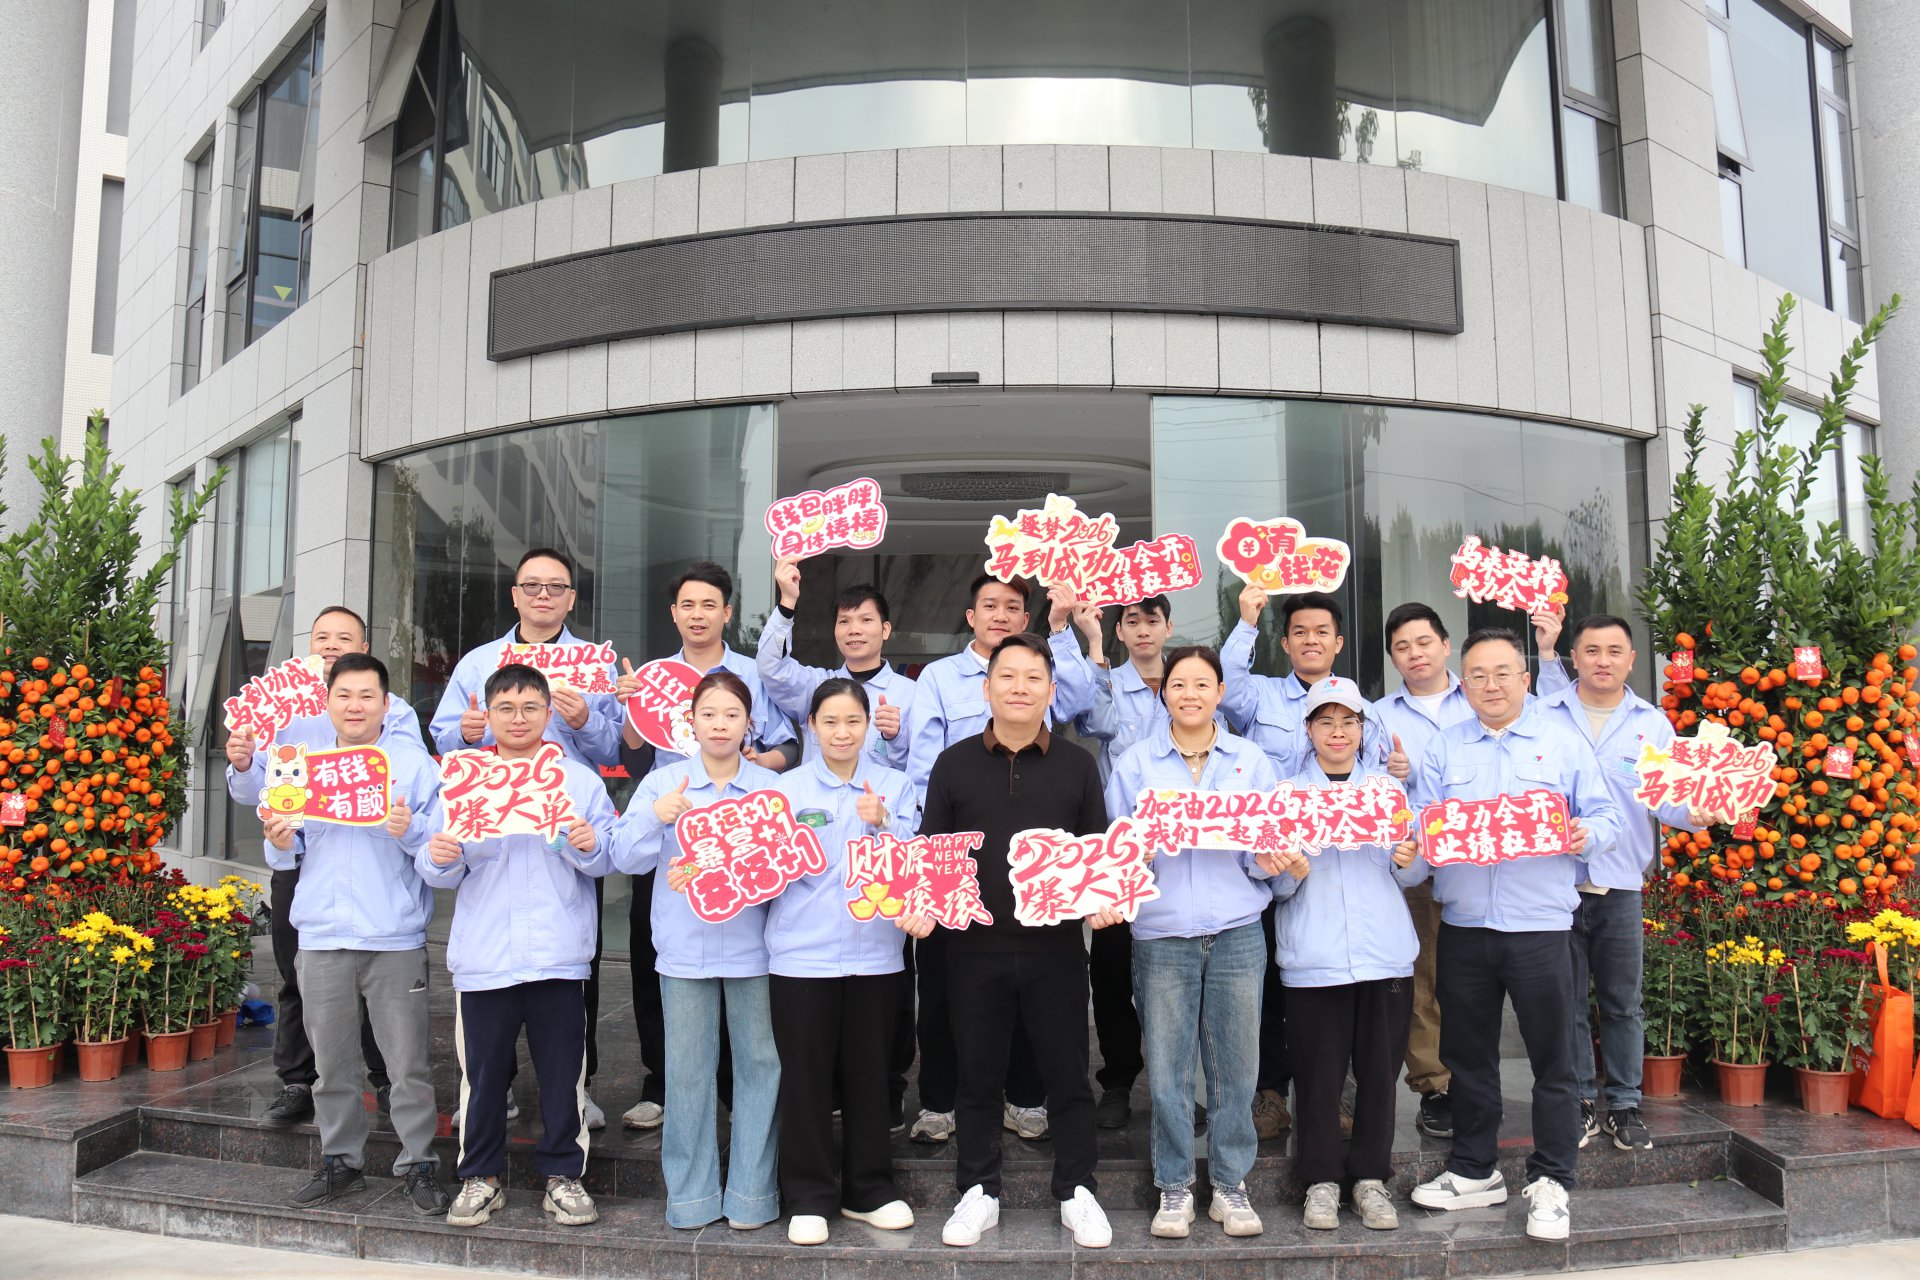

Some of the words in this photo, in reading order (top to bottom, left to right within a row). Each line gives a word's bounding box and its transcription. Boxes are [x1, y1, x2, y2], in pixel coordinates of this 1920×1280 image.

[772, 484, 872, 531] 钱包胖胖
[780, 508, 880, 556] 身体棒棒
[1116, 536, 1184, 575] 力全开
[990, 542, 1116, 589] 马到成功
[1451, 535, 1562, 596] 马来运转
[1453, 573, 1550, 614] 火力全开
[497, 641, 617, 669] 加油2026
[226, 658, 319, 730] 马到功成
[542, 666, 617, 694] 一起赢
[643, 662, 688, 704] 红红
[314, 754, 371, 788] 有钱
[443, 748, 565, 800] 2026
[1669, 740, 1774, 777] 逐梦2026
[327, 785, 386, 819] 有颜
[448, 790, 575, 839] 爆大单
[1136, 789, 1286, 821] 加油2026
[1276, 776, 1398, 827] 马来运转
[1442, 792, 1555, 832] 马力全开
[1638, 769, 1774, 821] 马到成功
[682, 794, 774, 844] 好运+1
[691, 812, 793, 869] 暴富+1
[933, 834, 982, 849] HAPPY
[1143, 817, 1289, 853] 我们一起赢
[1288, 815, 1398, 855] 火力全开
[691, 828, 822, 915] 幸福+1
[848, 835, 934, 886] 财源
[934, 849, 966, 862] NEW
[934, 861, 976, 876] YEAR
[1013, 821, 1140, 883] 2026
[903, 874, 993, 926] 滚滚
[1020, 864, 1155, 920] 爆大单
